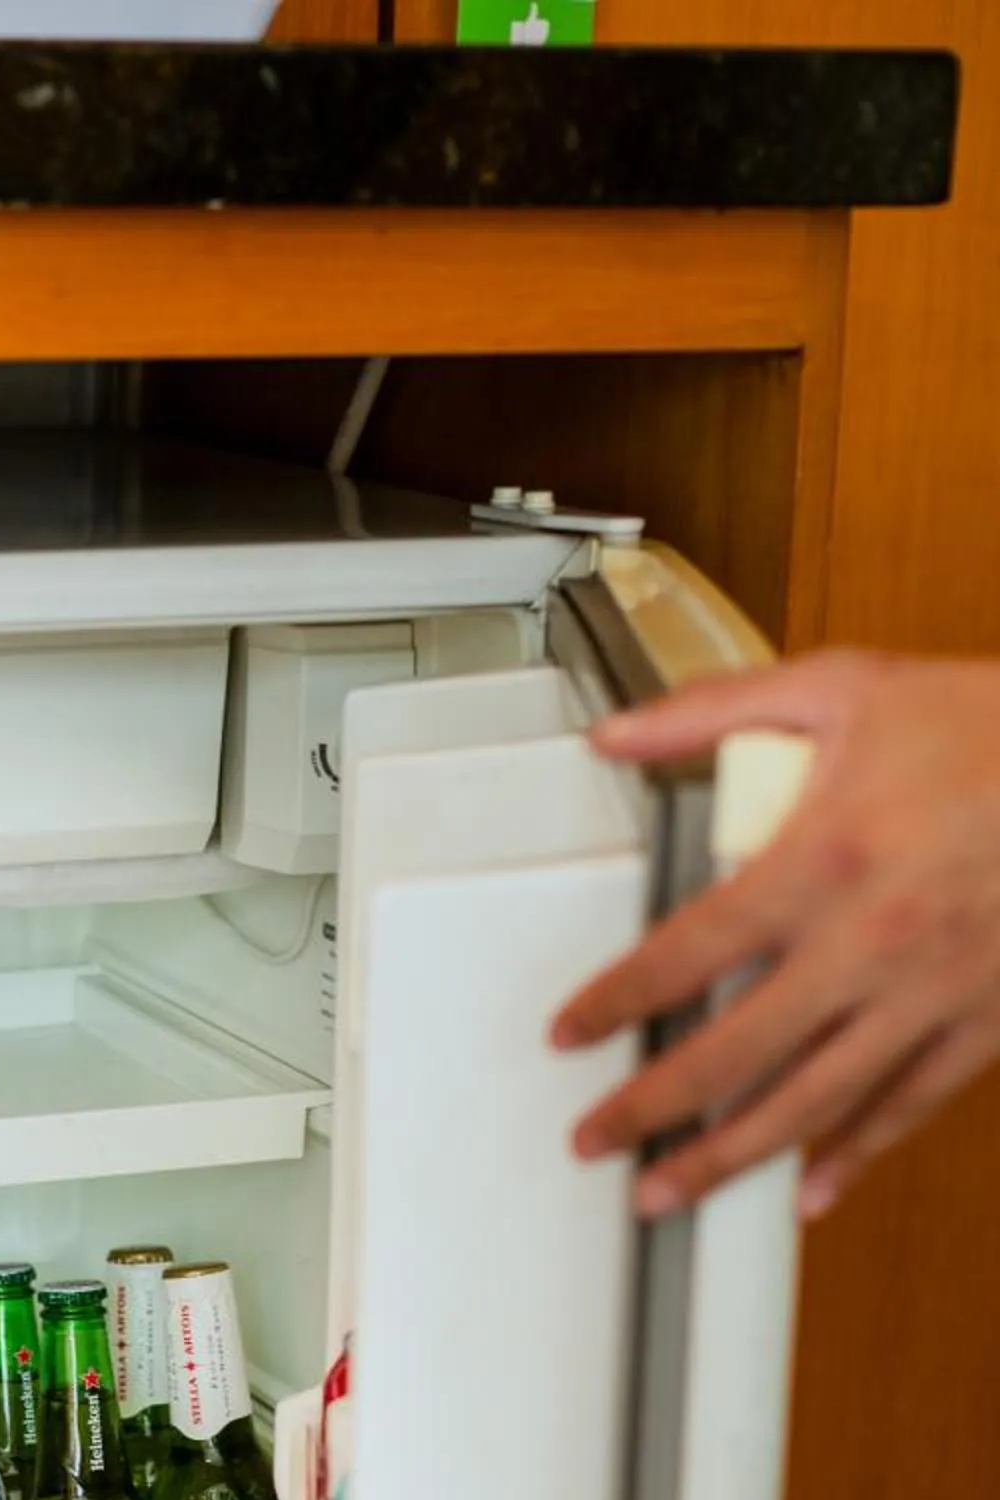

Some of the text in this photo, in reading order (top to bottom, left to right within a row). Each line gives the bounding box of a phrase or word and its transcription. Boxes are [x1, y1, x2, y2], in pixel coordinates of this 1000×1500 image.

[180, 1304, 203, 1426] STELLA ARTOIS
[18, 1369, 37, 1445] Heineken
[84, 1391, 104, 1471] Heineken
